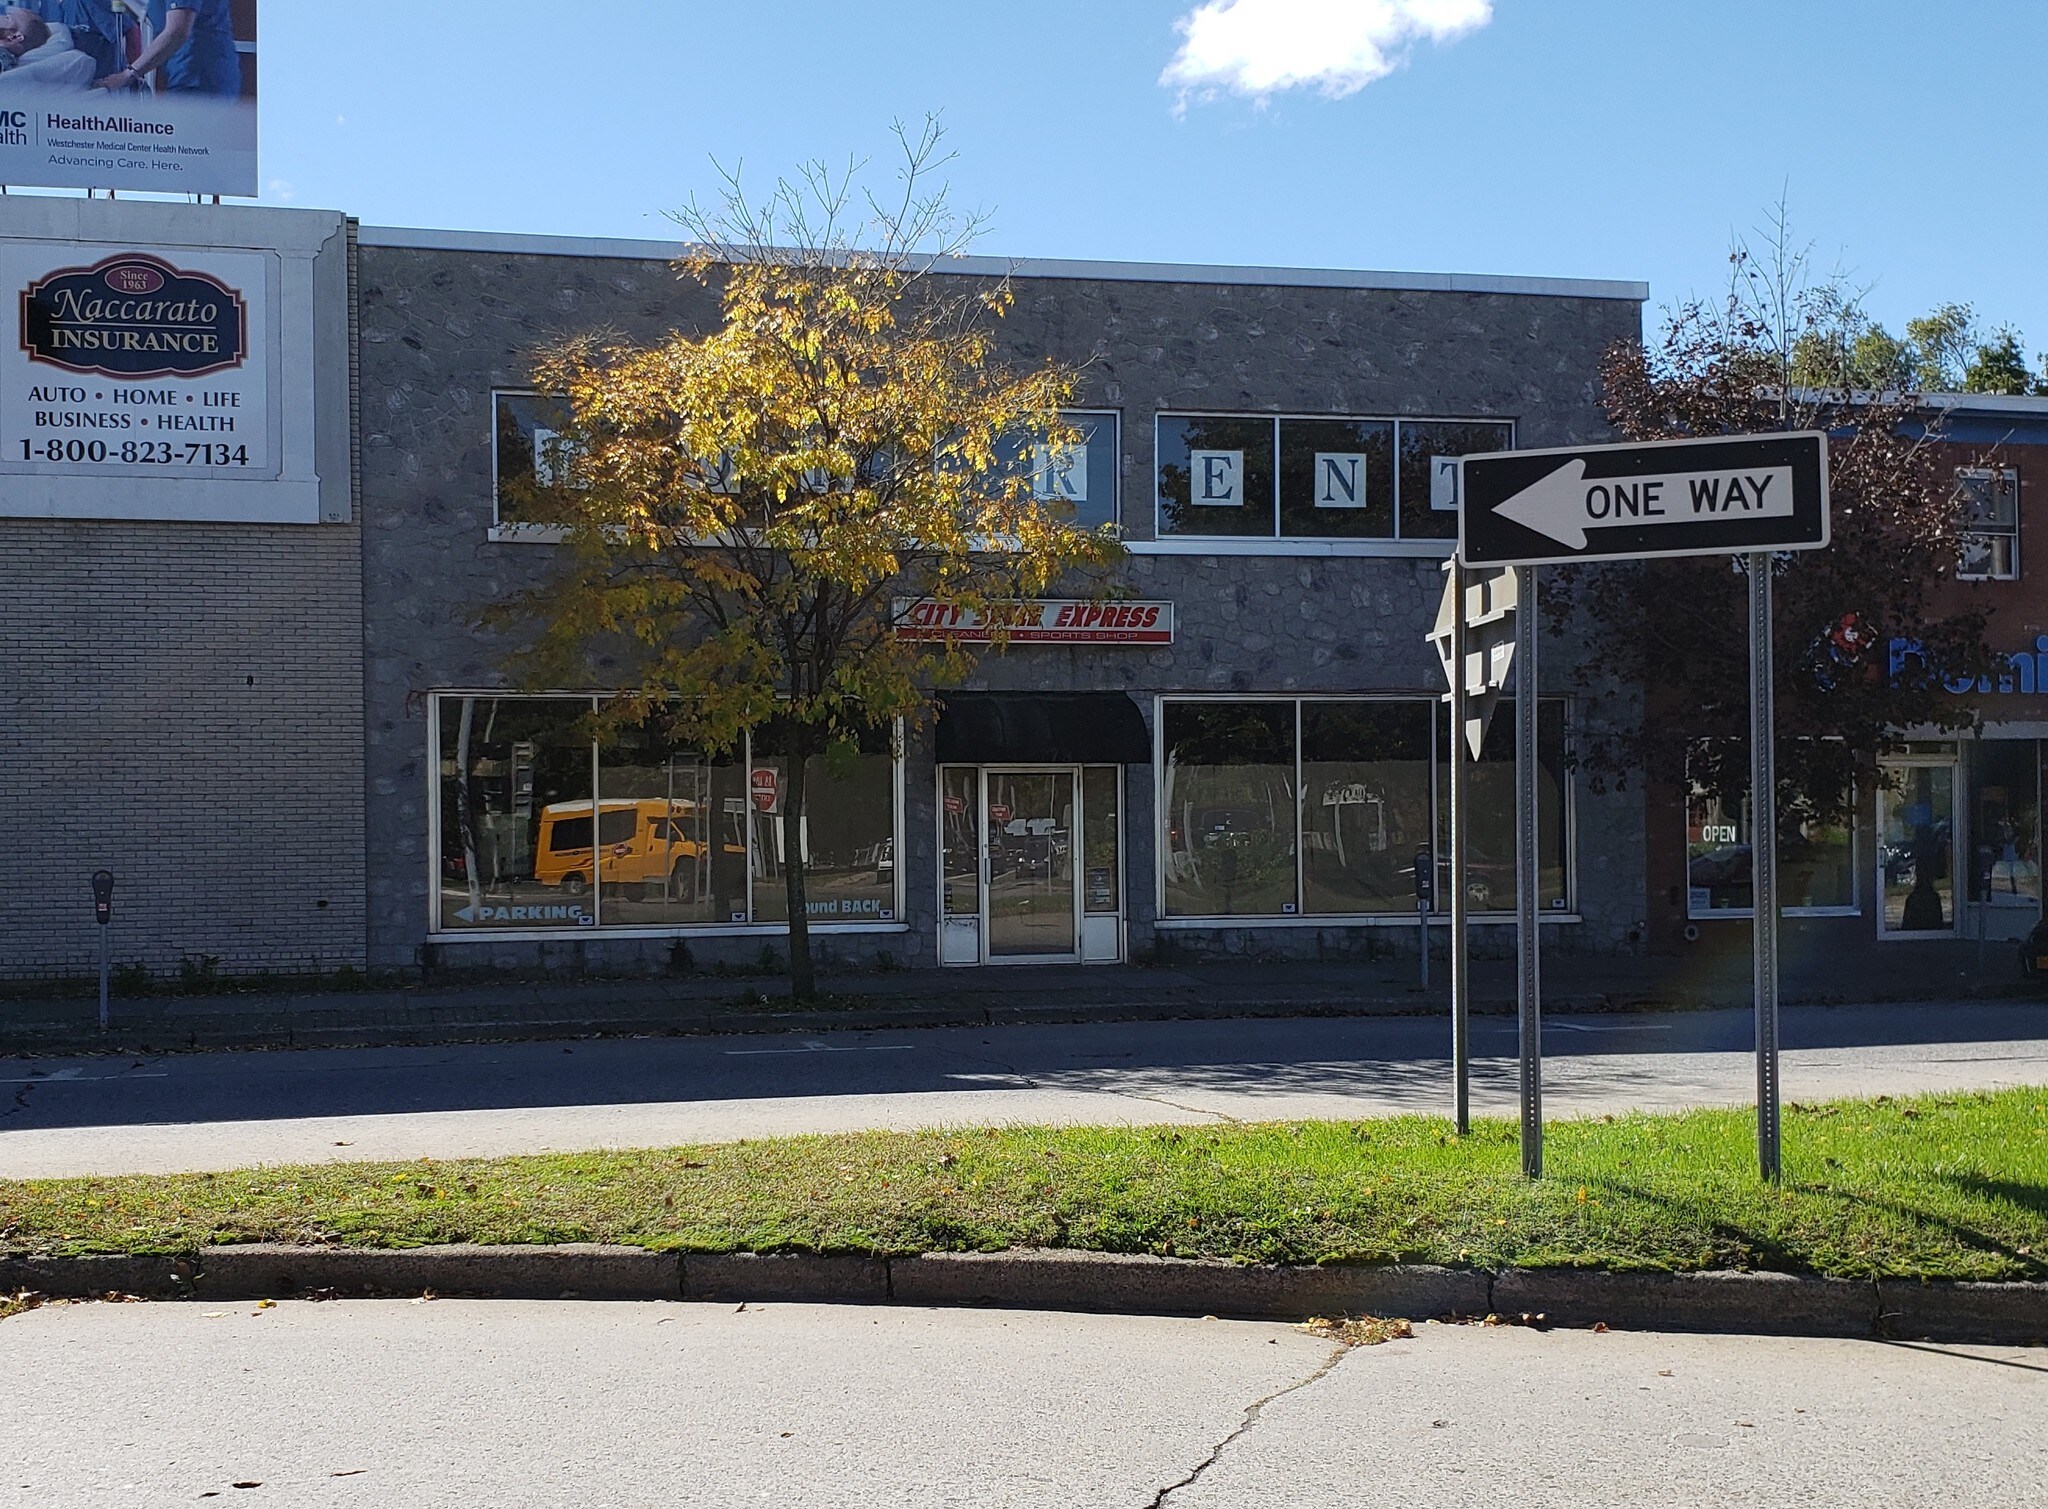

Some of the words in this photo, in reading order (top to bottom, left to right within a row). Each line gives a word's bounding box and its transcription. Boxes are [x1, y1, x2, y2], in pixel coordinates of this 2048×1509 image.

[47, 113, 174, 135] HealthAlliance
[47, 138, 94, 149] Westchester
[96, 141, 126, 151] Medical
[127, 142, 151, 153] Center
[153, 143, 176, 154] Health
[178, 145, 210, 156] Network
[48, 154, 114, 169] Advancing
[117, 158, 148, 169] Care.
[151, 159, 183, 171] Here.
[120, 270, 149, 281] Since
[123, 280, 147, 290] 1963
[51, 289, 218, 323] Naccarato
[51, 329, 219, 353] INSURANCE
[28, 386, 87, 403] AUTO
[113, 388, 178, 406] HOME
[203, 391, 241, 408] LIFE
[35, 411, 131, 429] BUSINESS
[157, 415, 235, 432] HEALTH
[19, 438, 249, 466] 1-800-823-7134
[1585, 481, 1666, 520] ONE
[1688, 474, 1774, 514] WAY
[1054, 605, 1160, 628] EXPRESS
[1029, 631, 1092, 640] SPORTS
[1095, 631, 1138, 640] SHOP
[1702, 825, 1736, 842] OPEN
[479, 905, 583, 921] PARKING
[841, 899, 881, 914] BACK
